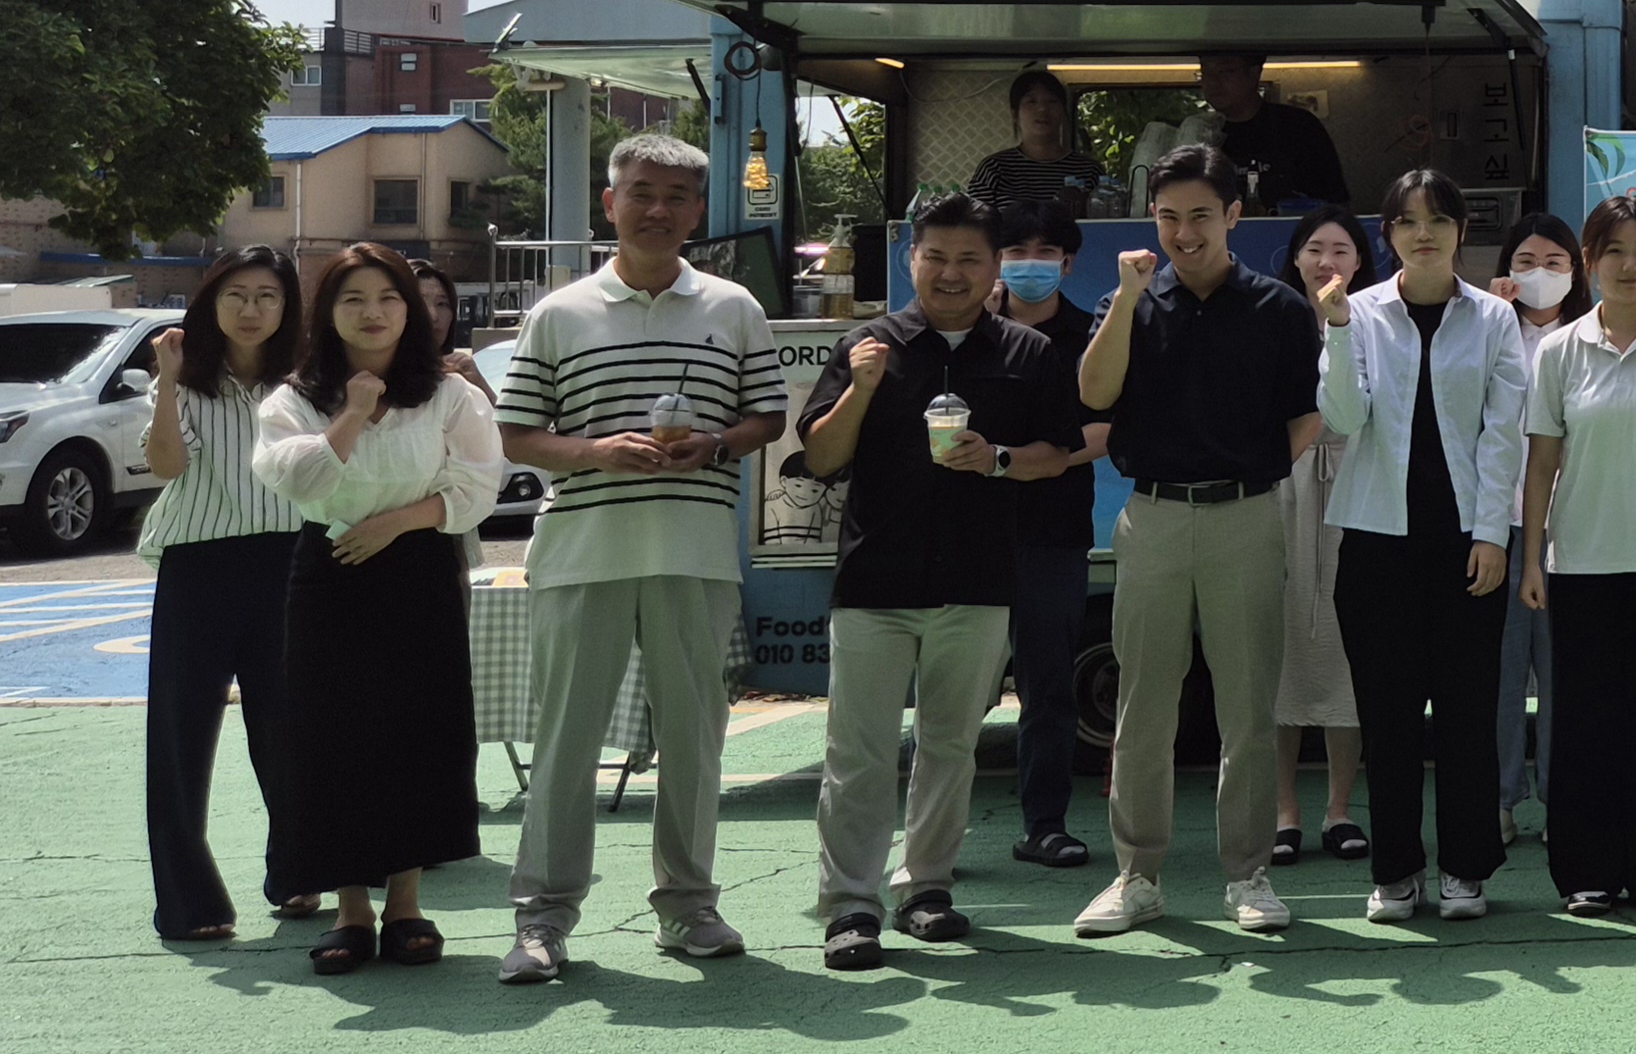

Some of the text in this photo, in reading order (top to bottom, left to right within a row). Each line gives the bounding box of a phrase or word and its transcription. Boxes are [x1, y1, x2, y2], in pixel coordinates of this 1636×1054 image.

[778, 345, 833, 367] ORD
[756, 615, 831, 637] Food
[756, 644, 794, 665] 010
